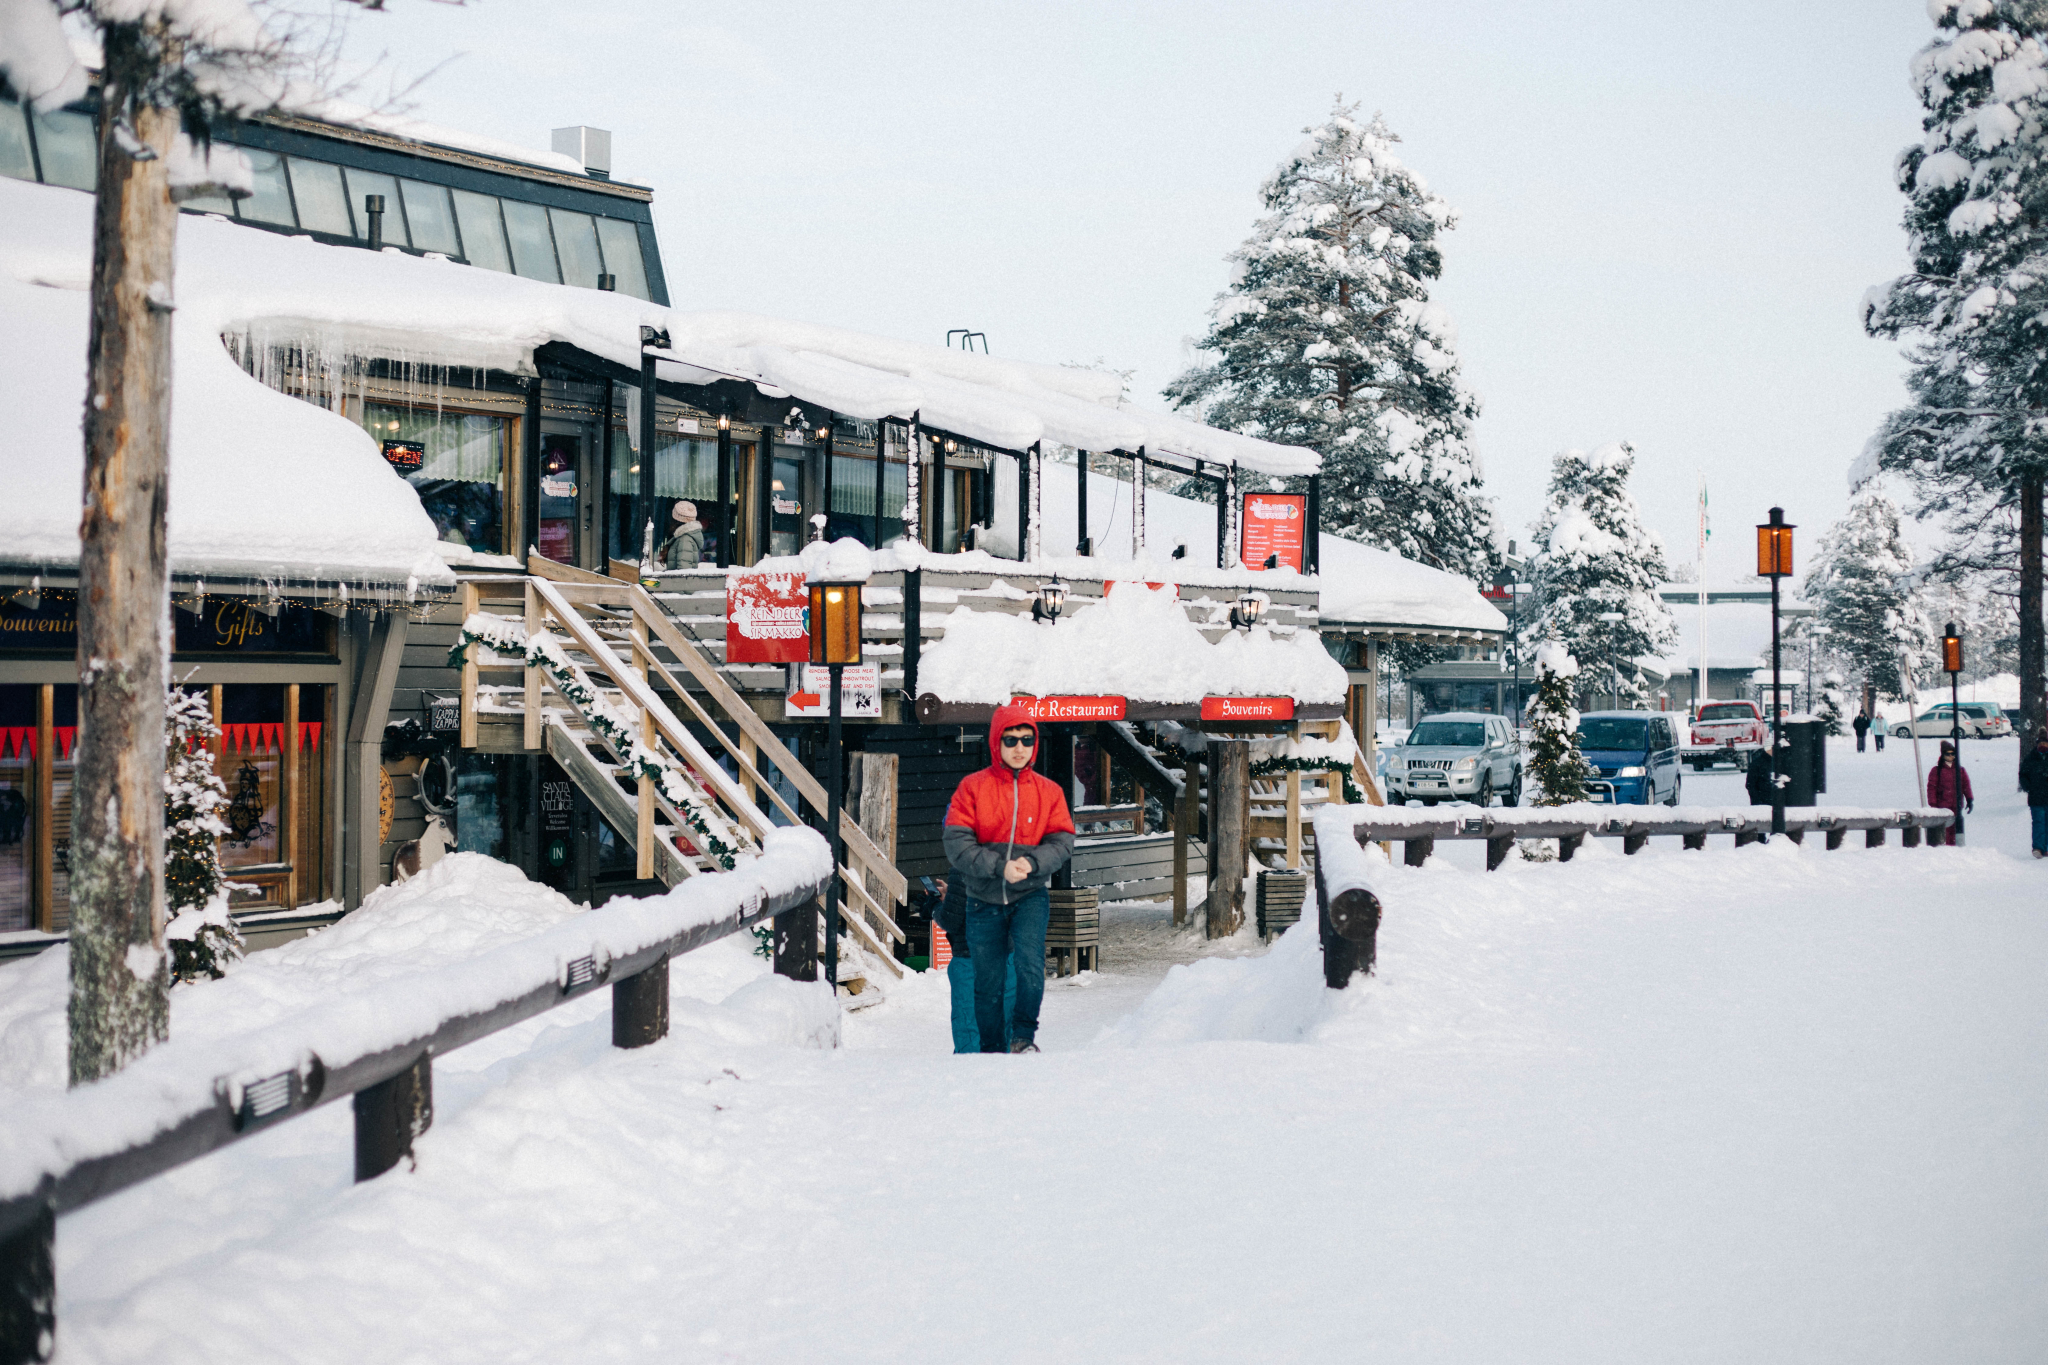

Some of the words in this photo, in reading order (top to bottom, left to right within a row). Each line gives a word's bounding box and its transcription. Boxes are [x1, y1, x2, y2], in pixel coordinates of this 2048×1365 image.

[388, 448, 422, 464] OPEN
[215, 601, 263, 646] Gifts
[1048, 700, 1119, 717] Restaurant
[1222, 700, 1273, 717] Souvenirs
[543, 782, 570, 792] SANTA
[543, 791, 571, 801] CLAUS
[540, 800, 573, 811] VILLAGE
[553, 847, 563, 859] IN
